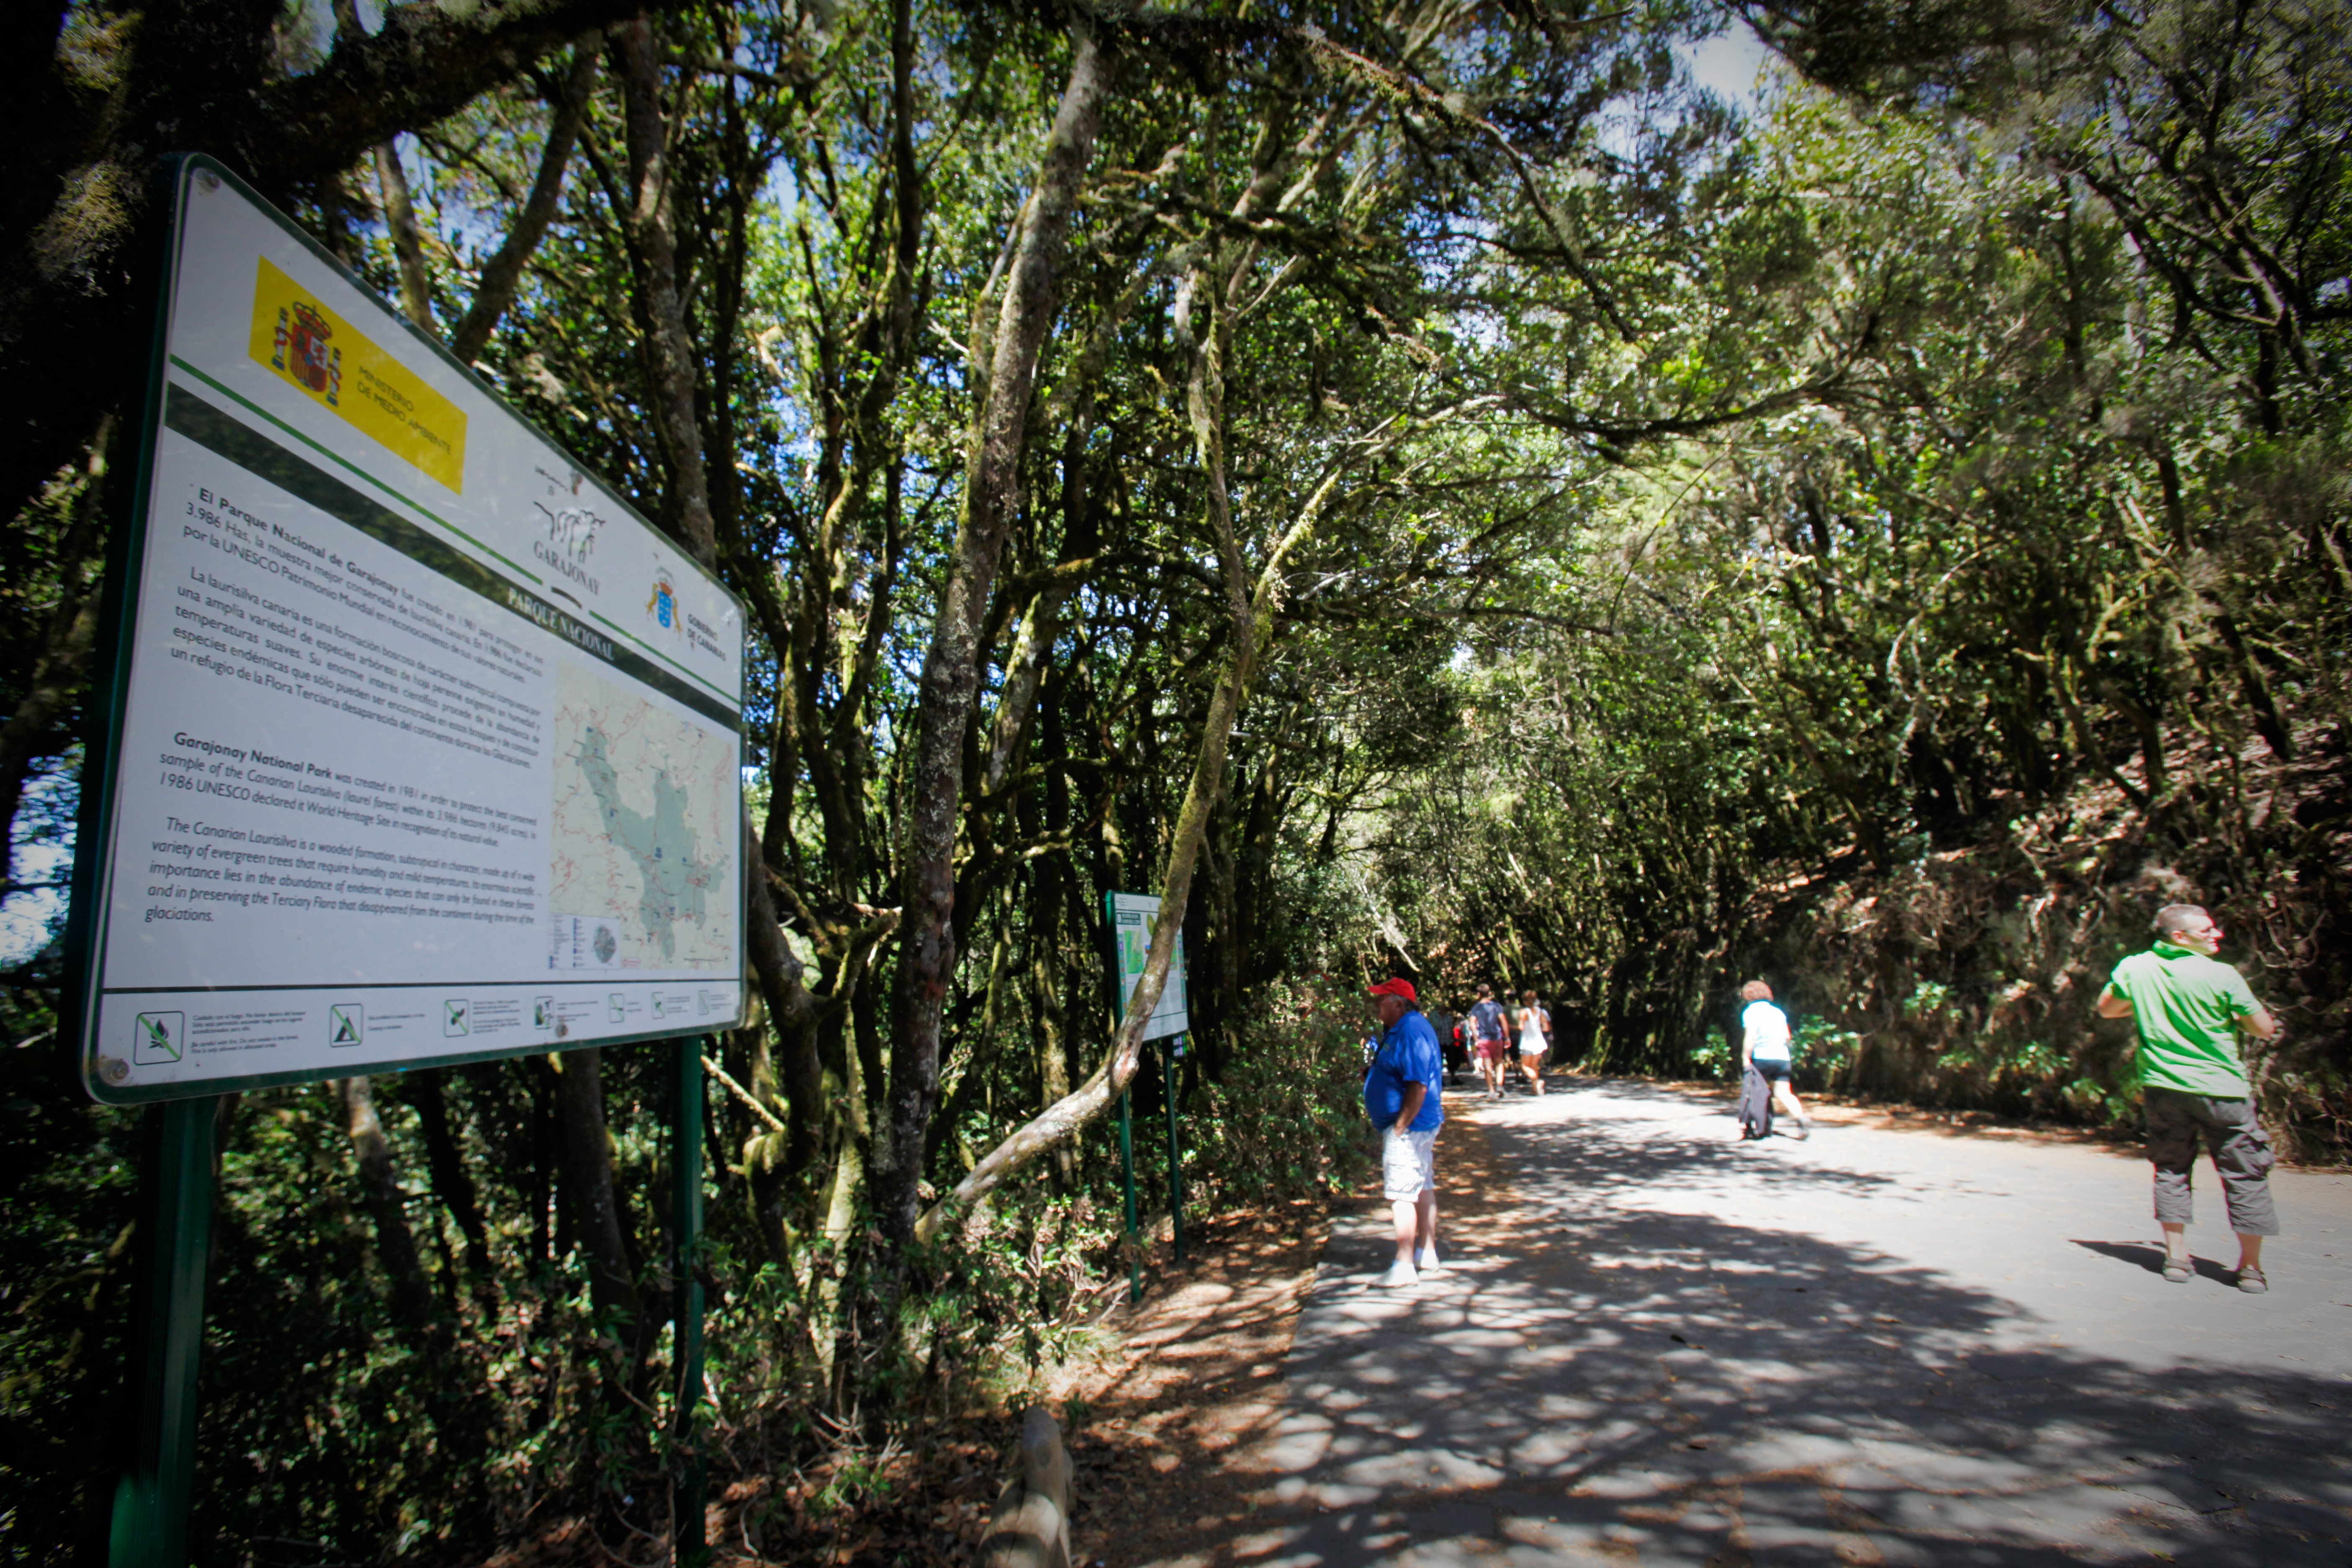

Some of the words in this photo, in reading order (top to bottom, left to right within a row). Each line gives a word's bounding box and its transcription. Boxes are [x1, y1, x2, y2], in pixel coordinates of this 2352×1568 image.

[359, 366, 414, 412] MINISTERIO
[358, 381, 371, 398] DE
[374, 393, 405, 421] MEDIO
[408, 420, 451, 455] AMBIENTE
[186, 502, 220, 528] 3.986
[225, 521, 251, 544] Has,
[255, 535, 264, 549] la
[268, 544, 311, 571] muestra
[314, 566, 343, 584] mejor
[199, 487, 213, 504] El
[219, 498, 268, 531] Parque
[272, 524, 325, 558] Nacional
[329, 554, 343, 567] de
[183, 525, 208, 541] por
[209, 534, 220, 549] la
[222, 539, 279, 573] UNESCO
[281, 565, 338, 600] Patrimonio
[534, 541, 598, 595] GARAJONAY
[178, 586, 200, 602] una
[205, 597, 245, 619] amplia
[249, 614, 296, 638] variedad
[300, 632, 312, 645] de
[316, 640, 356, 661] especies
[191, 567, 205, 583] La
[208, 574, 259, 605] laurisilva
[262, 599, 300, 621] canaria
[302, 616, 313, 626] es
[315, 621, 333, 634] una
[508, 587, 557, 629] PARQUE
[560, 617, 614, 660] NACIONAL
[688, 614, 717, 641] GOBIERNO
[173, 627, 227, 652] especies
[230, 647, 289, 673] endémicas
[291, 668, 311, 681] que
[313, 675, 335, 689] sólo
[175, 606, 259, 644] temperaturas
[266, 639, 302, 659] suaves.
[309, 652, 322, 666] Su
[327, 662, 364, 681] enorme
[688, 628, 695, 641] DE
[697, 635, 725, 661] CANARIAS
[171, 648, 188, 660] un
[190, 655, 235, 676] refugio
[237, 667, 251, 681] de
[253, 671, 263, 684] la
[265, 674, 293, 694] Flora
[296, 684, 340, 709] Terciaria
[160, 754, 205, 772] sample
[209, 762, 223, 775] of
[224, 764, 243, 779] the
[247, 769, 294, 789] Canarian
[297, 780, 341, 799] Laurisilva
[343, 790, 371, 806] (laurel
[174, 732, 247, 763] Garajonay
[250, 750, 304, 772] National
[307, 763, 332, 779] Park
[335, 774, 351, 784] was
[354, 778, 386, 792] created
[161, 772, 193, 790] 1986
[196, 779, 250, 800] UNESCO
[252, 791, 297, 810] declared
[297, 801, 304, 811] it
[307, 801, 335, 817] World
[337, 807, 374, 826] Heritage
[152, 841, 194, 859] variety
[196, 844, 210, 858] of
[210, 846, 266, 865] evergreen
[268, 855, 293, 867] trees
[296, 857, 315, 870] that
[317, 862, 350, 874] require
[351, 864, 387, 881] humidity
[167, 817, 190, 833] The
[193, 822, 246, 841] Canarian
[249, 830, 297, 848] Laurisilva
[299, 839, 307, 849] is
[309, 842, 316, 851] a
[318, 844, 353, 856] wooded
[147, 884, 174, 897] and
[175, 885, 187, 898] in
[189, 888, 250, 907] preserving
[252, 892, 268, 904] the
[272, 892, 312, 910] Terciary
[313, 896, 337, 909] Flora
[338, 899, 356, 910] that
[150, 860, 221, 879] importance
[224, 868, 242, 882] lies
[245, 871, 255, 882] in
[259, 872, 276, 885] the
[279, 874, 333, 890] abundance
[335, 880, 346, 892] of
[346, 881, 382, 895] endemic
[144, 905, 214, 923] glaciations.
